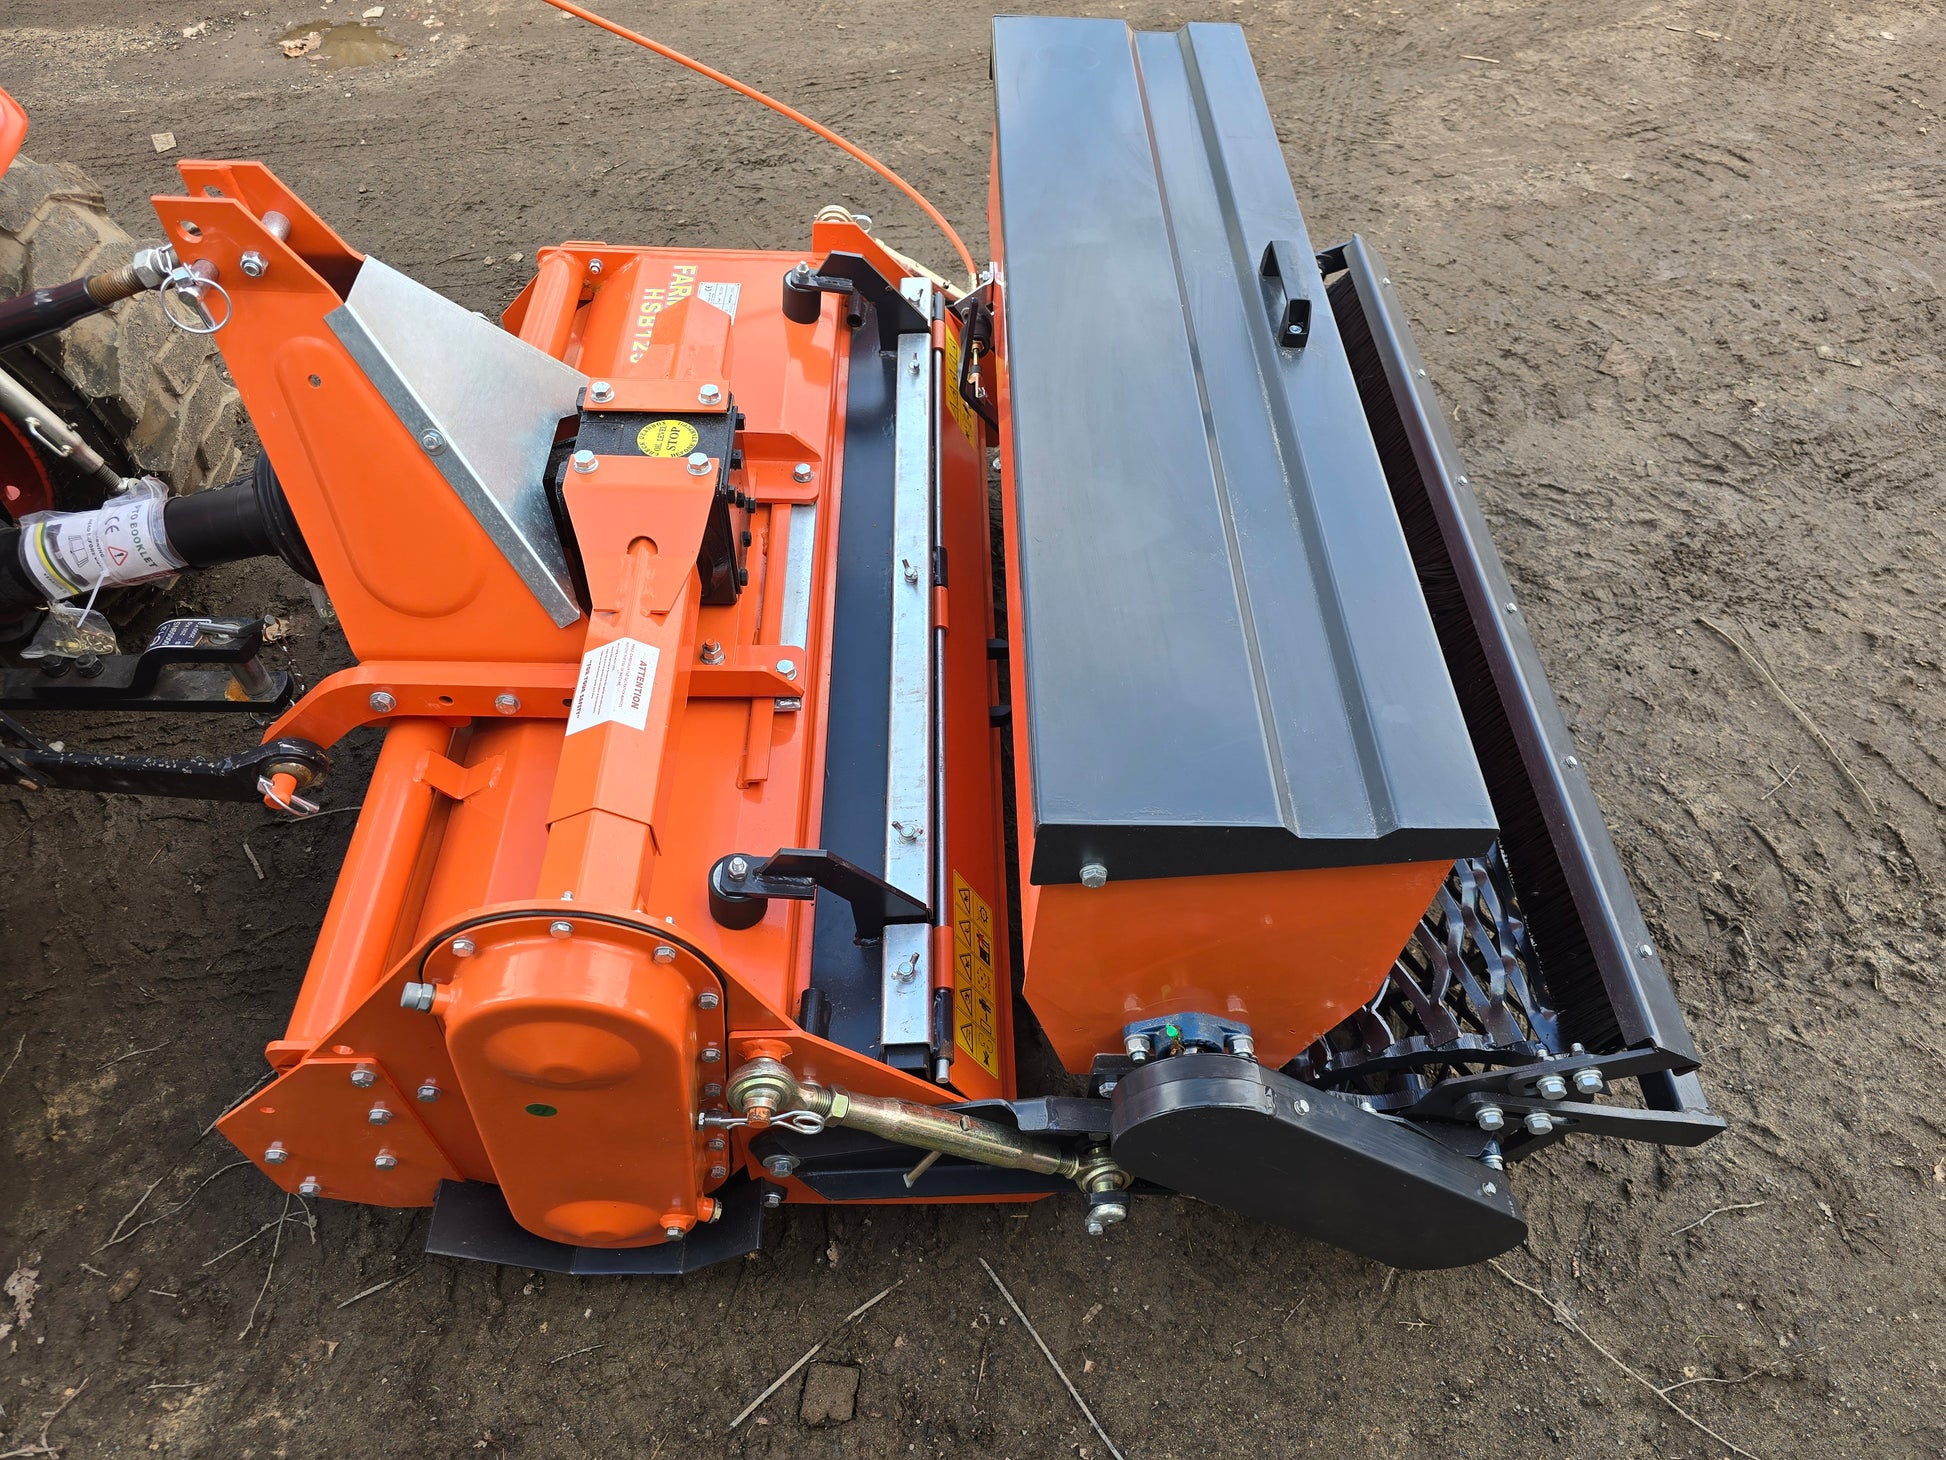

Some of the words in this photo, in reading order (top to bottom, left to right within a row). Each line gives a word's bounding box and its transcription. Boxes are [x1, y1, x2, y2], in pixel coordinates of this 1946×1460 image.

[656, 425, 667, 442] LEVEL
[666, 426, 680, 452] STOP
[130, 523, 158, 568] BOOKLET
[631, 659, 647, 709] ATTENTION
